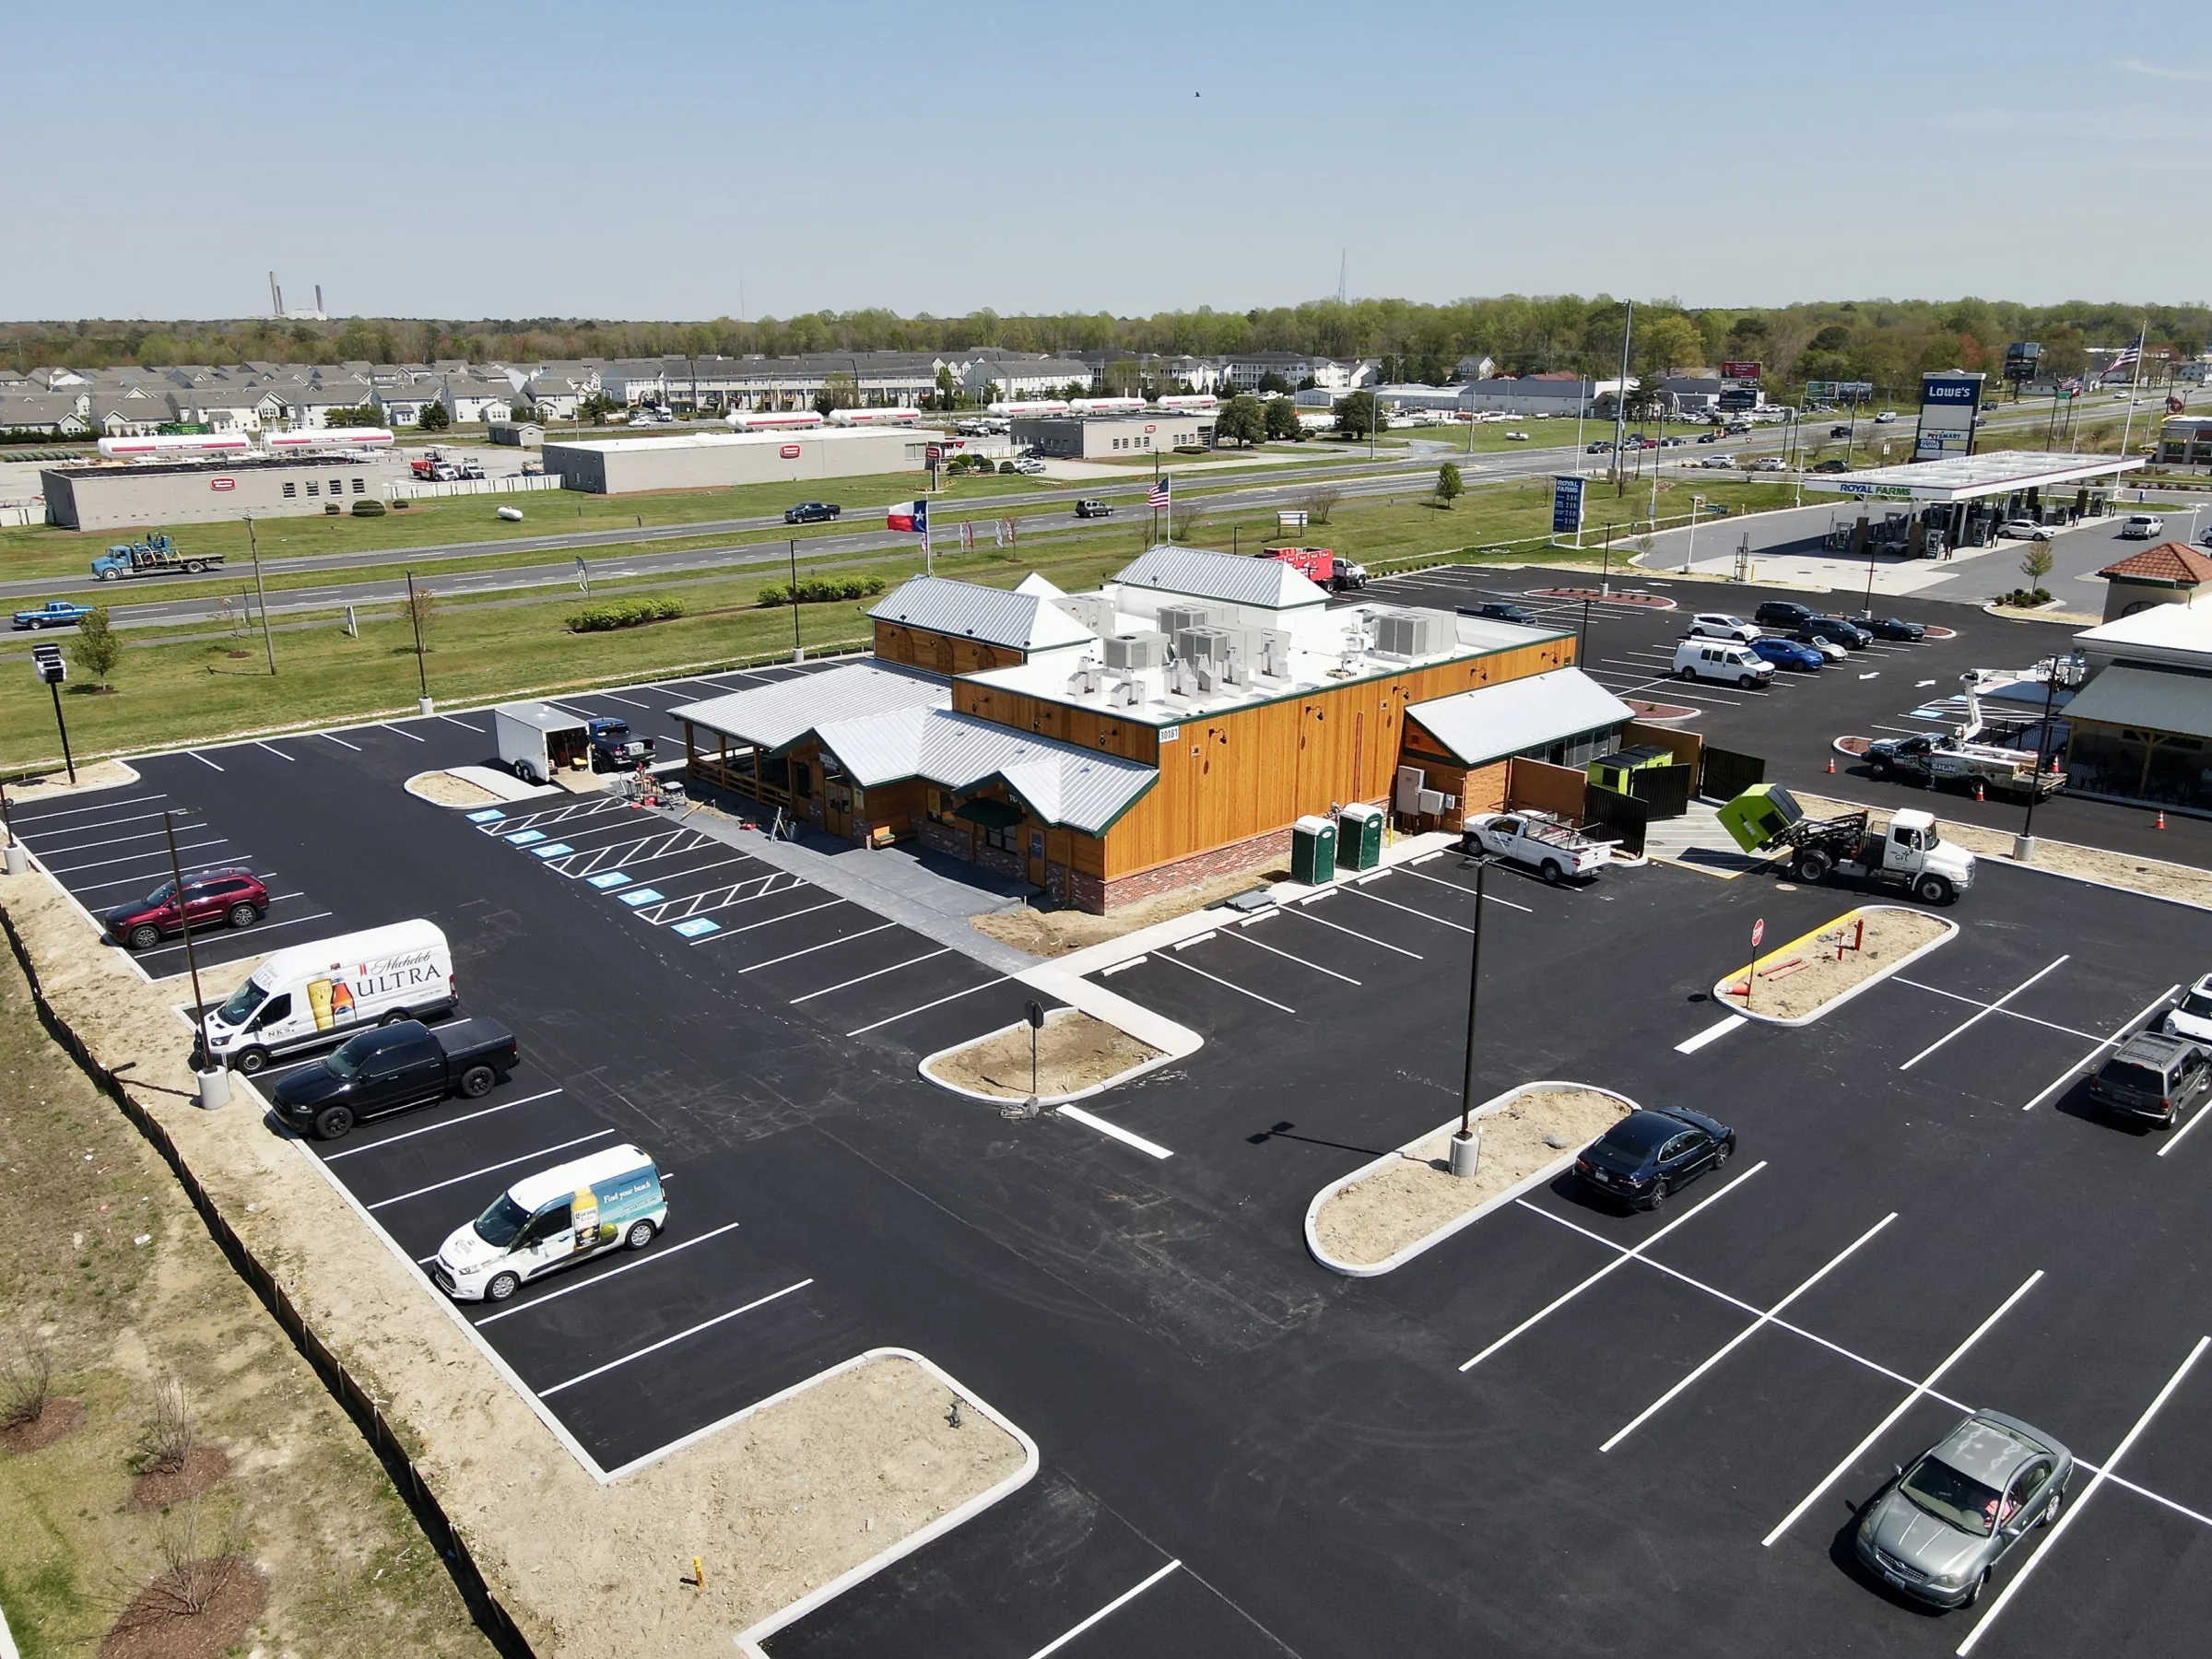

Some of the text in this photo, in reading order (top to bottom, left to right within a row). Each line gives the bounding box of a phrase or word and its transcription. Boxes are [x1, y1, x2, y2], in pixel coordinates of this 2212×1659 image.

[1928, 386, 1971, 397] LOWE'S
[1840, 484, 1912, 496] ROYAL FARMS
[371, 949, 431, 975] Michelob
[356, 963, 441, 997] ULTRA
[603, 1192, 618, 1204] Find
[618, 1187, 633, 1201] your
[633, 1180, 652, 1194] beach
